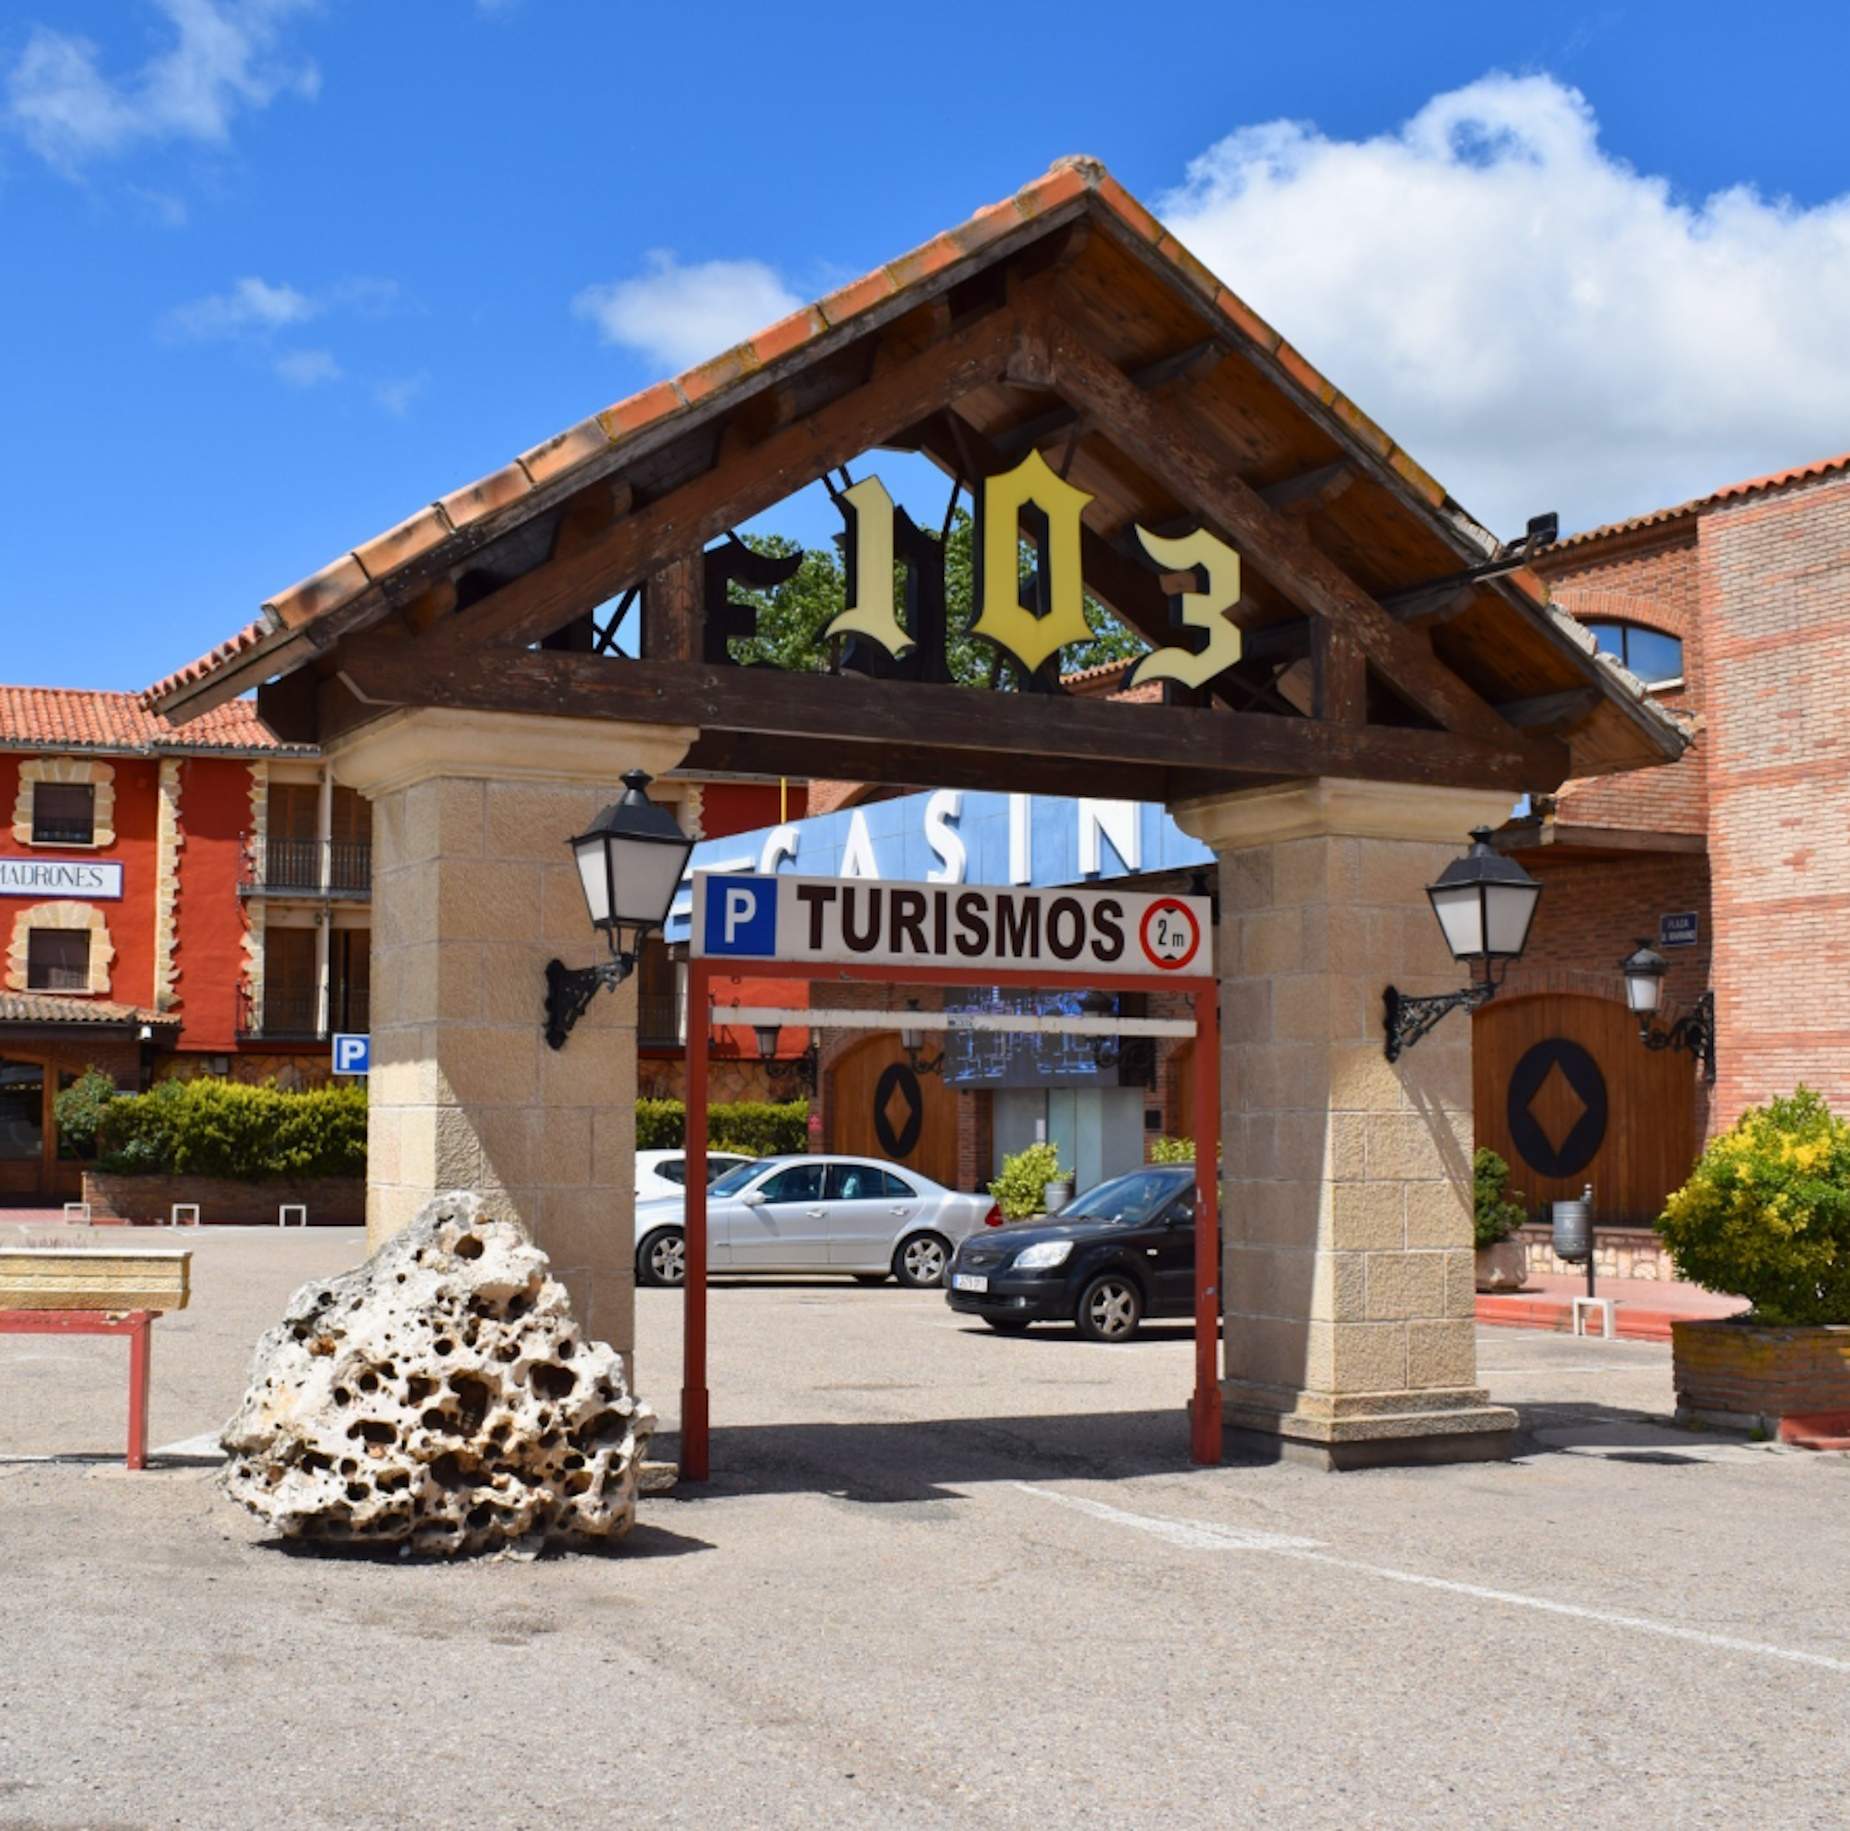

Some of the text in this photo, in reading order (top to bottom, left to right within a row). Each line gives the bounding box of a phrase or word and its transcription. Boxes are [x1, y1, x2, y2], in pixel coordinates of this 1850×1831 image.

[825, 448, 1242, 689] 103
[724, 884, 1185, 962] P TURISMOS 2 m
[340, 1040, 366, 1069] P
